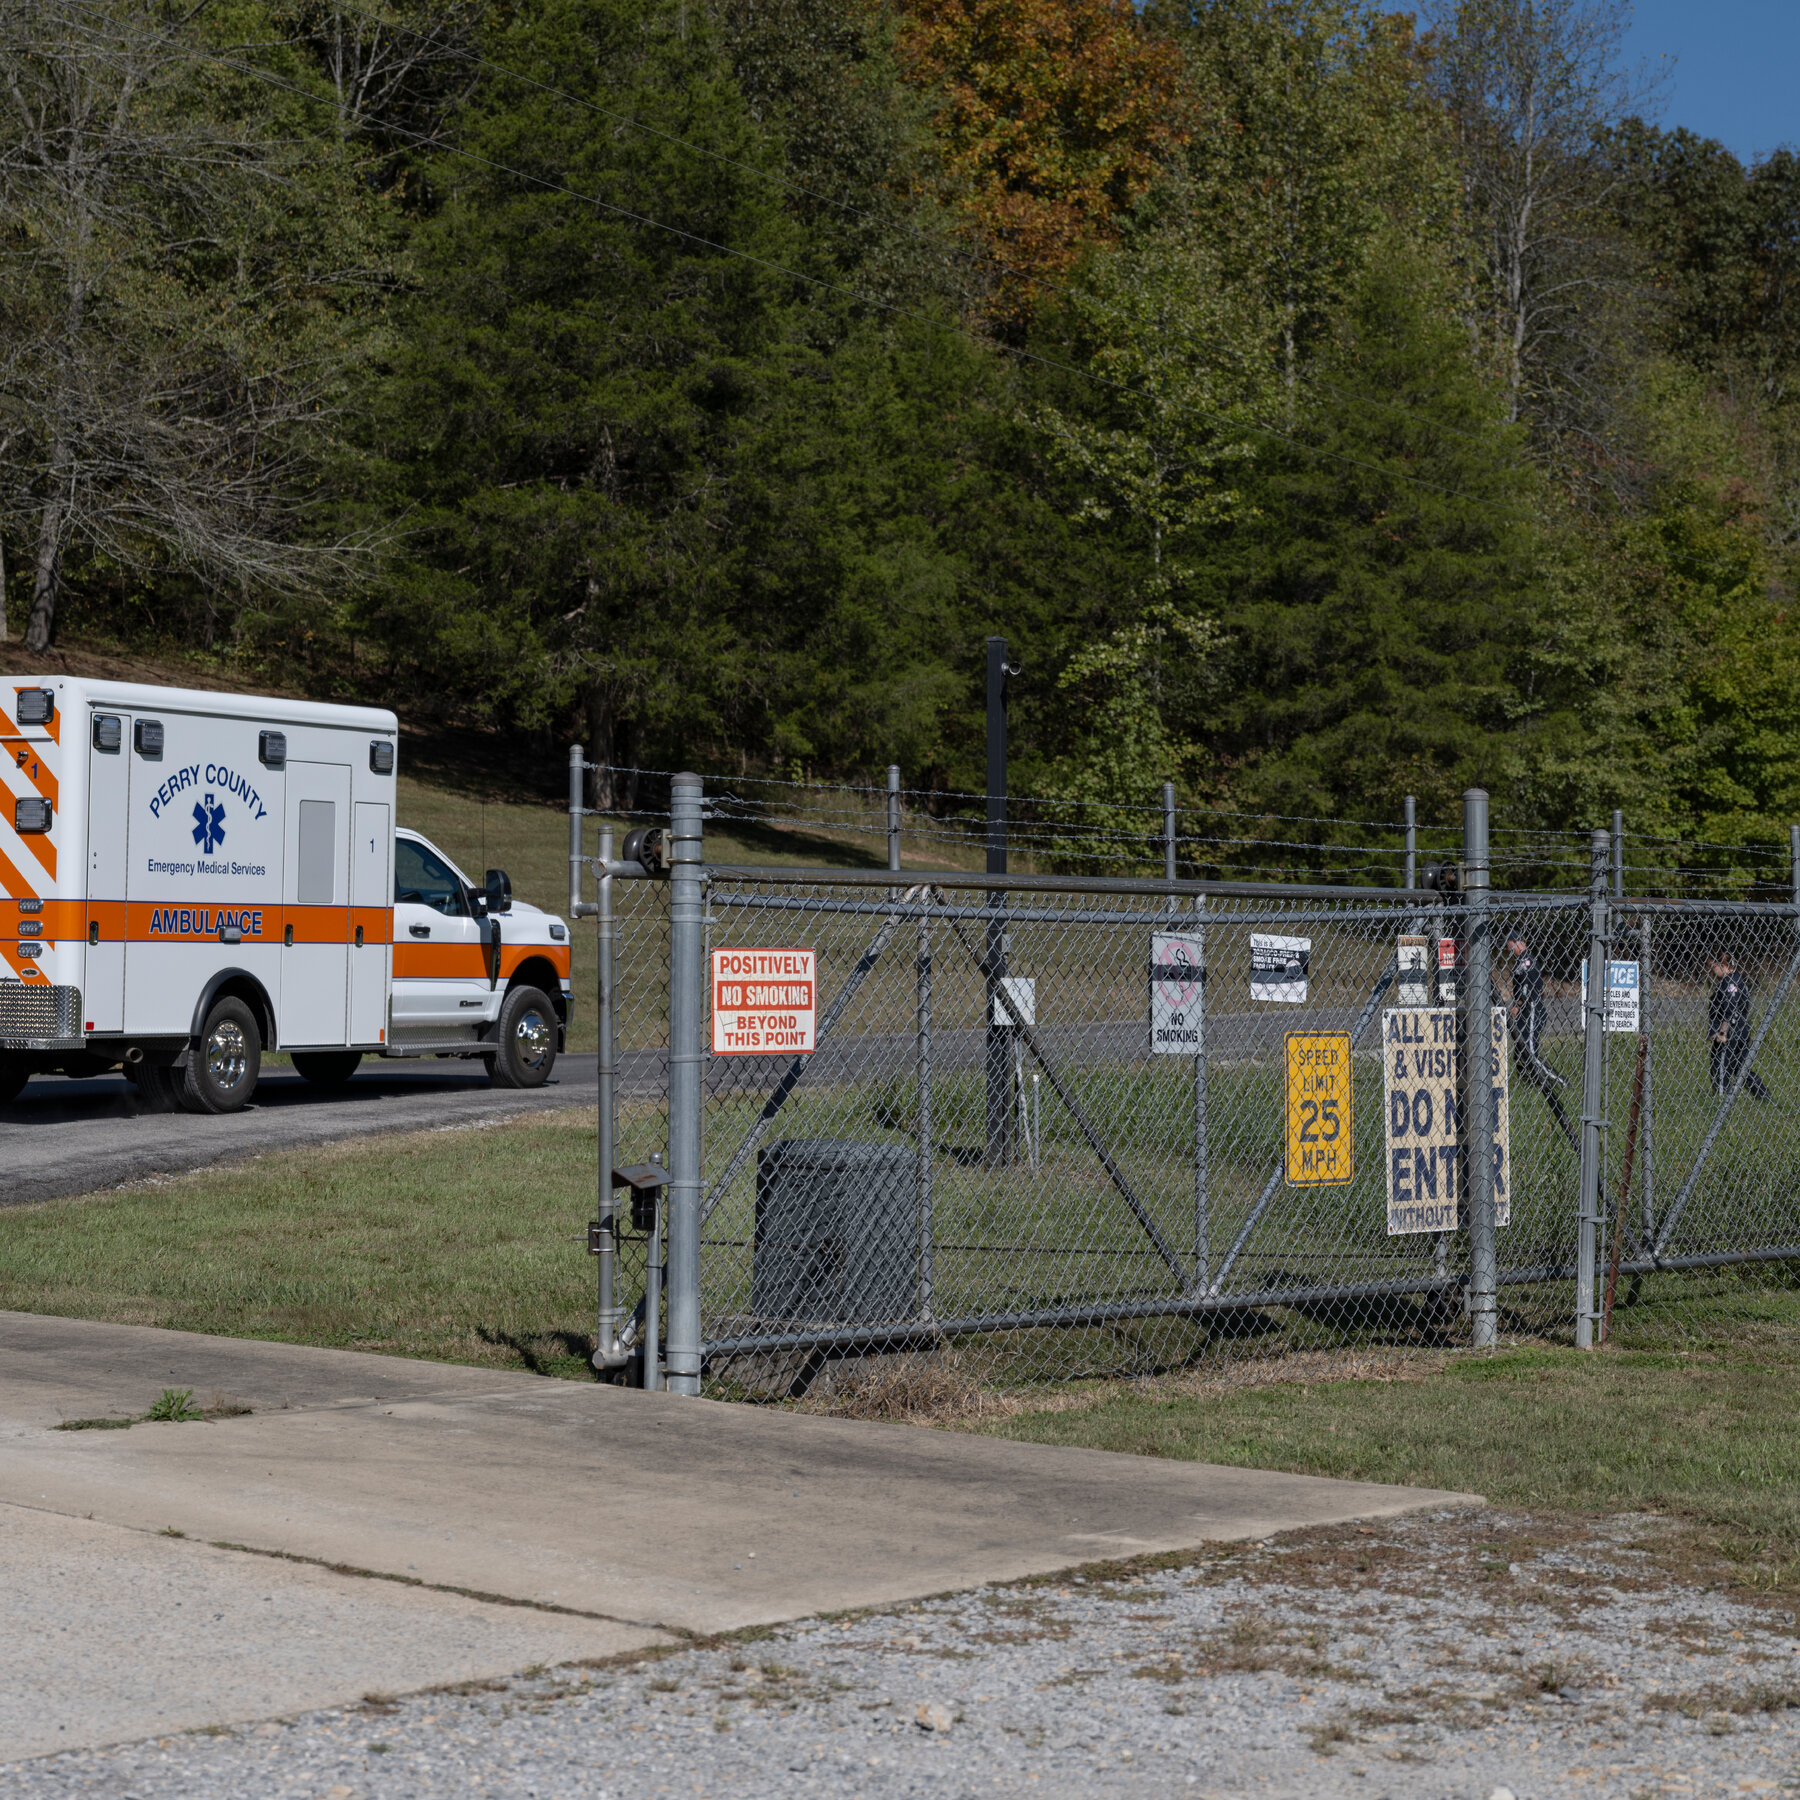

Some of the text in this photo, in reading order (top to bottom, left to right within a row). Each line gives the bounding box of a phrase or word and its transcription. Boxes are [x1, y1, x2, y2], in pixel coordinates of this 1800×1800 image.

[31, 763, 38, 779] 1
[149, 764, 267, 820] PERRY COUNTY
[369, 838, 374, 853] 1
[148, 859, 265, 876] Emergency Medical Services
[149, 909, 263, 935] AMBULANCE
[720, 955, 810, 974] POSITIVELY
[721, 985, 809, 1006] NO SMOKING
[737, 1016, 797, 1029] BEYOND
[1171, 1012, 1184, 1026] NO
[1387, 1013, 1503, 1043] ALL TRUS
[725, 1031, 806, 1046] THIS POINT
[1156, 1029, 1198, 1042] SMOKING
[1298, 1050, 1338, 1066] SPEED
[1394, 1048, 1500, 1079] & VISITS
[1303, 1075, 1335, 1092] LIMIT
[1300, 1100, 1340, 1142] 25
[1391, 1087, 1504, 1137] DO NT
[1302, 1149, 1337, 1172] MPH
[1392, 1143, 1506, 1202] ENTR
[1391, 1205, 1453, 1230] WITHOUT
